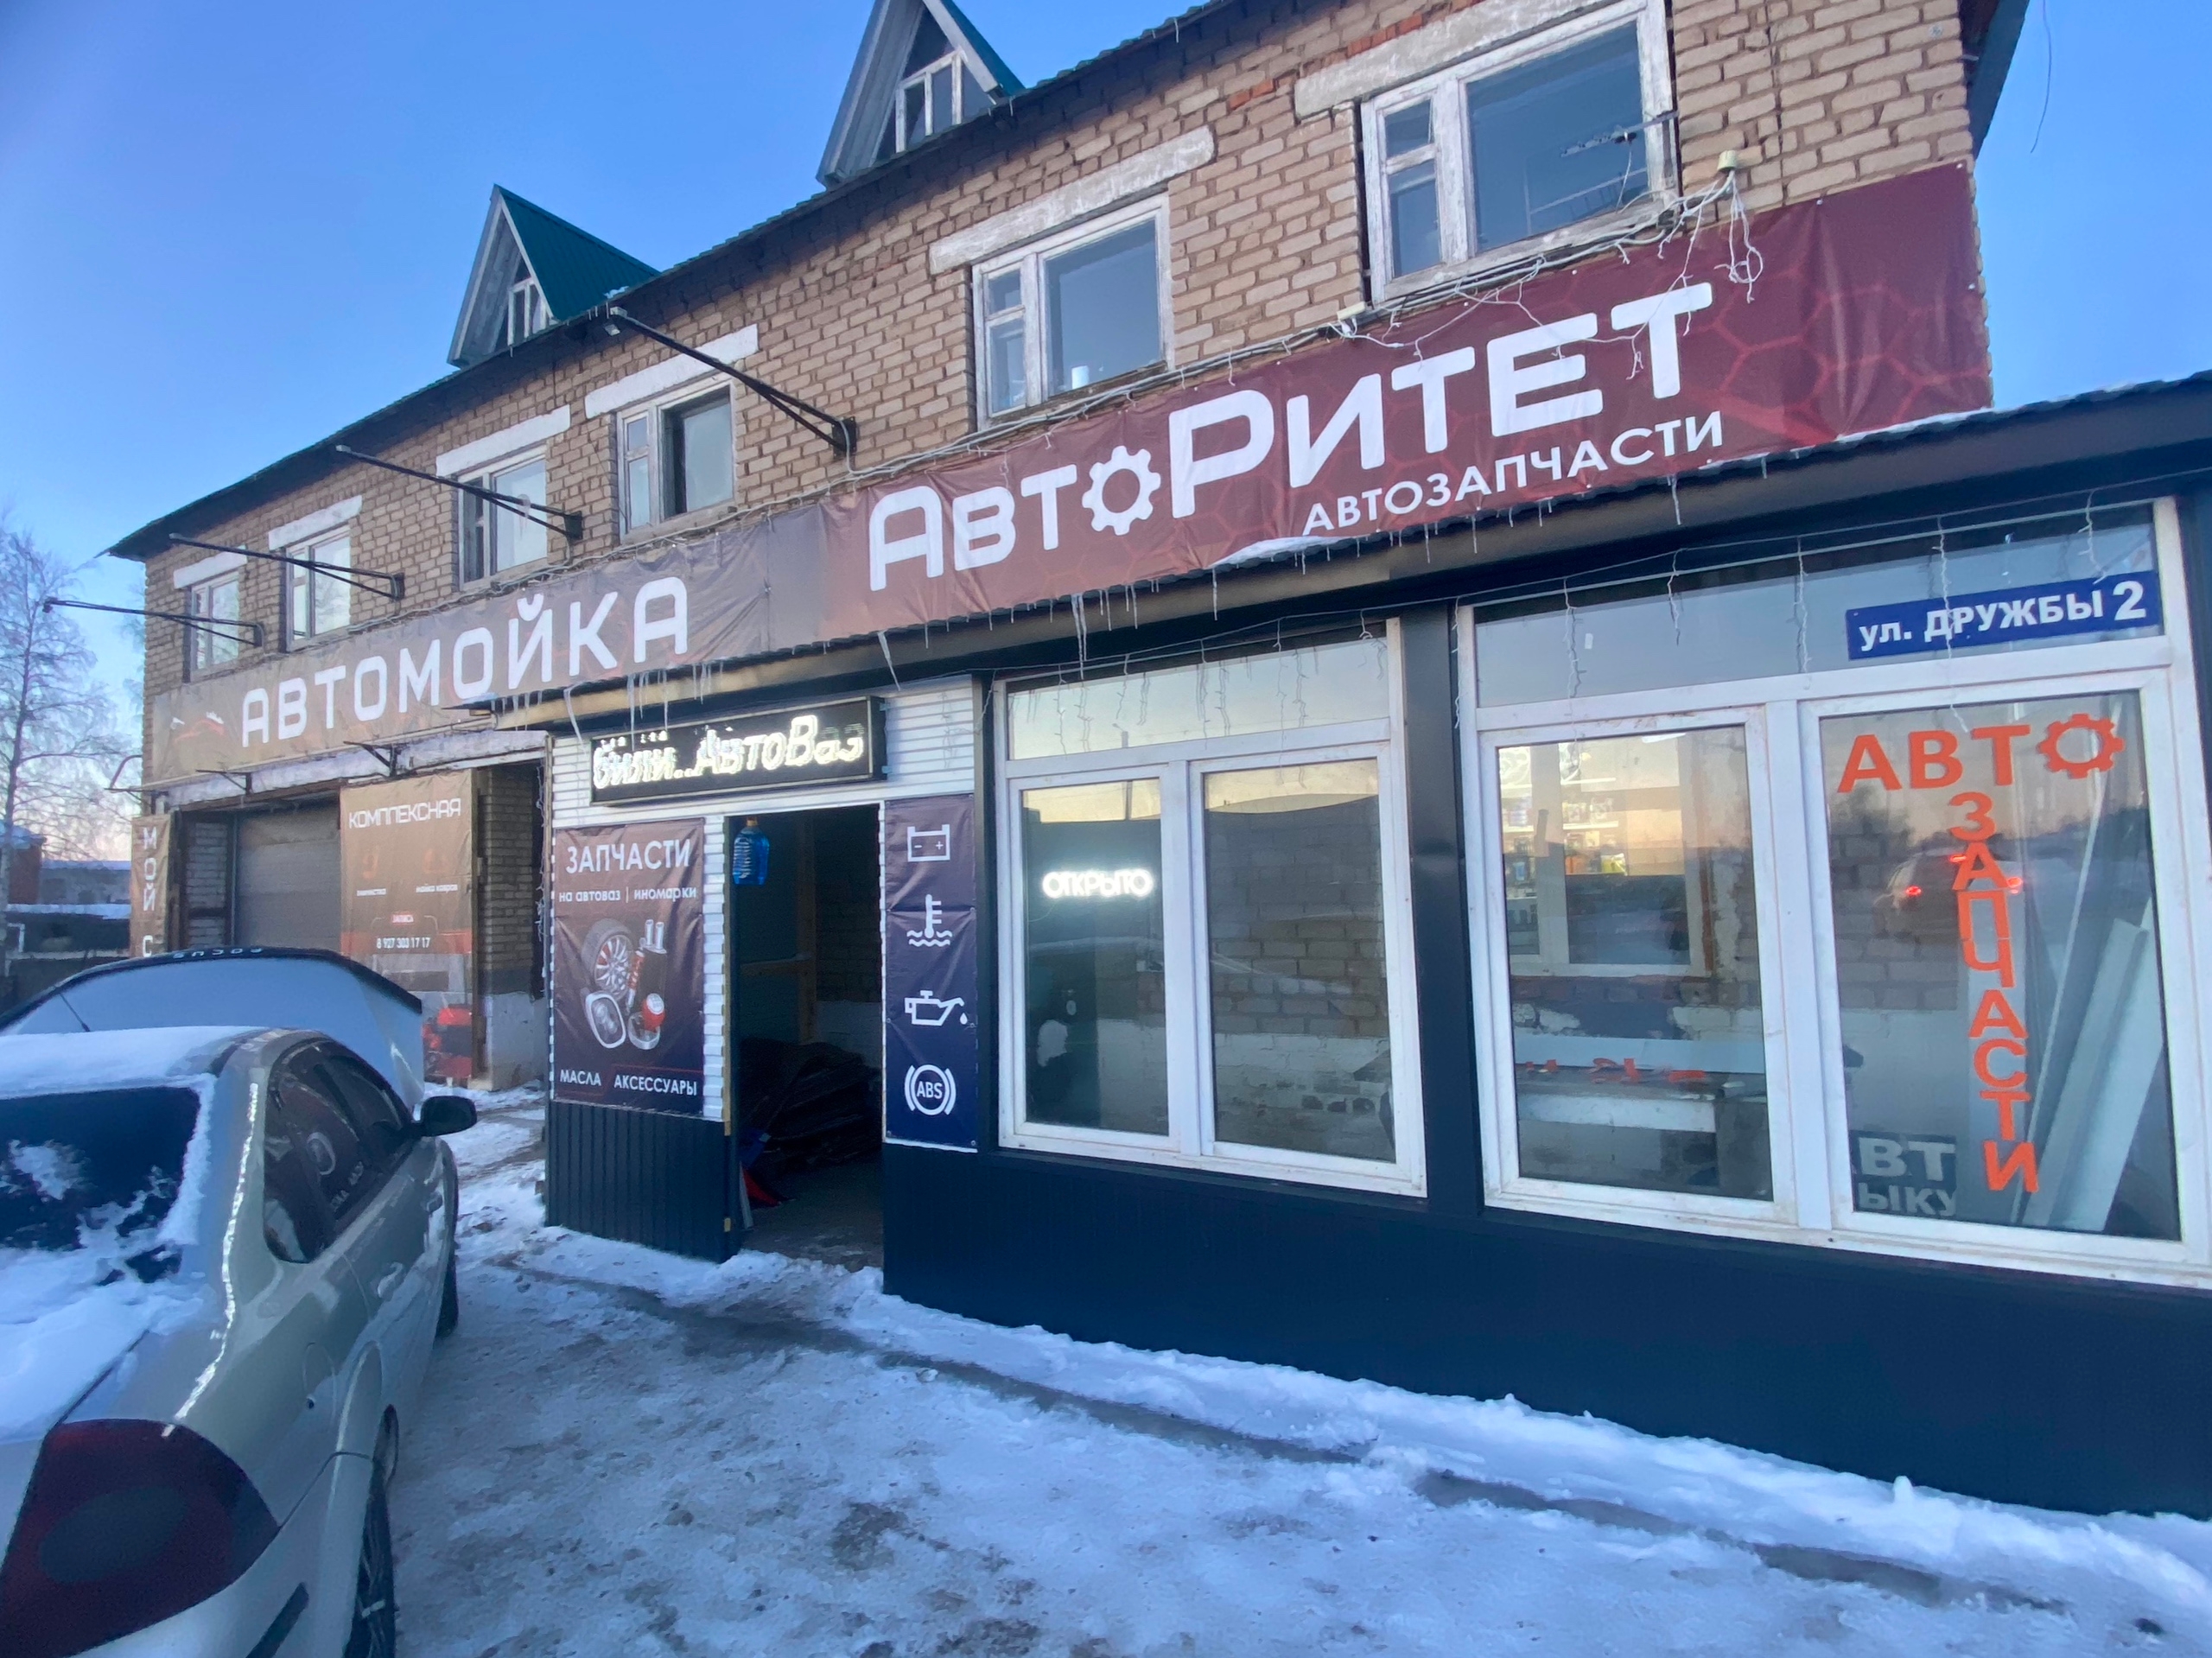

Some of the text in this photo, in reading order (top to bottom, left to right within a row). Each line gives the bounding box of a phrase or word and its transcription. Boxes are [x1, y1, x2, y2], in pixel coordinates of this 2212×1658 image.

[1303, 411, 1724, 536] АВТОЗАПЧАСТИ
[1859, 580, 2147, 651] ул. ДРУЖБЫ 2
[242, 576, 688, 748] АВТОМОЙКА
[566, 839, 691, 874] ЗАПЧАСТИ
[558, 886, 697, 903] на автоваз иномарки
[1041, 868, 1154, 899] ОТКРЫТО
[1948, 791, 2039, 1193] ЗАПЧАСТИ
[560, 1069, 698, 1096] МАСЛА АКСЕССУАРЫ
[916, 1081, 944, 1100] ABS
